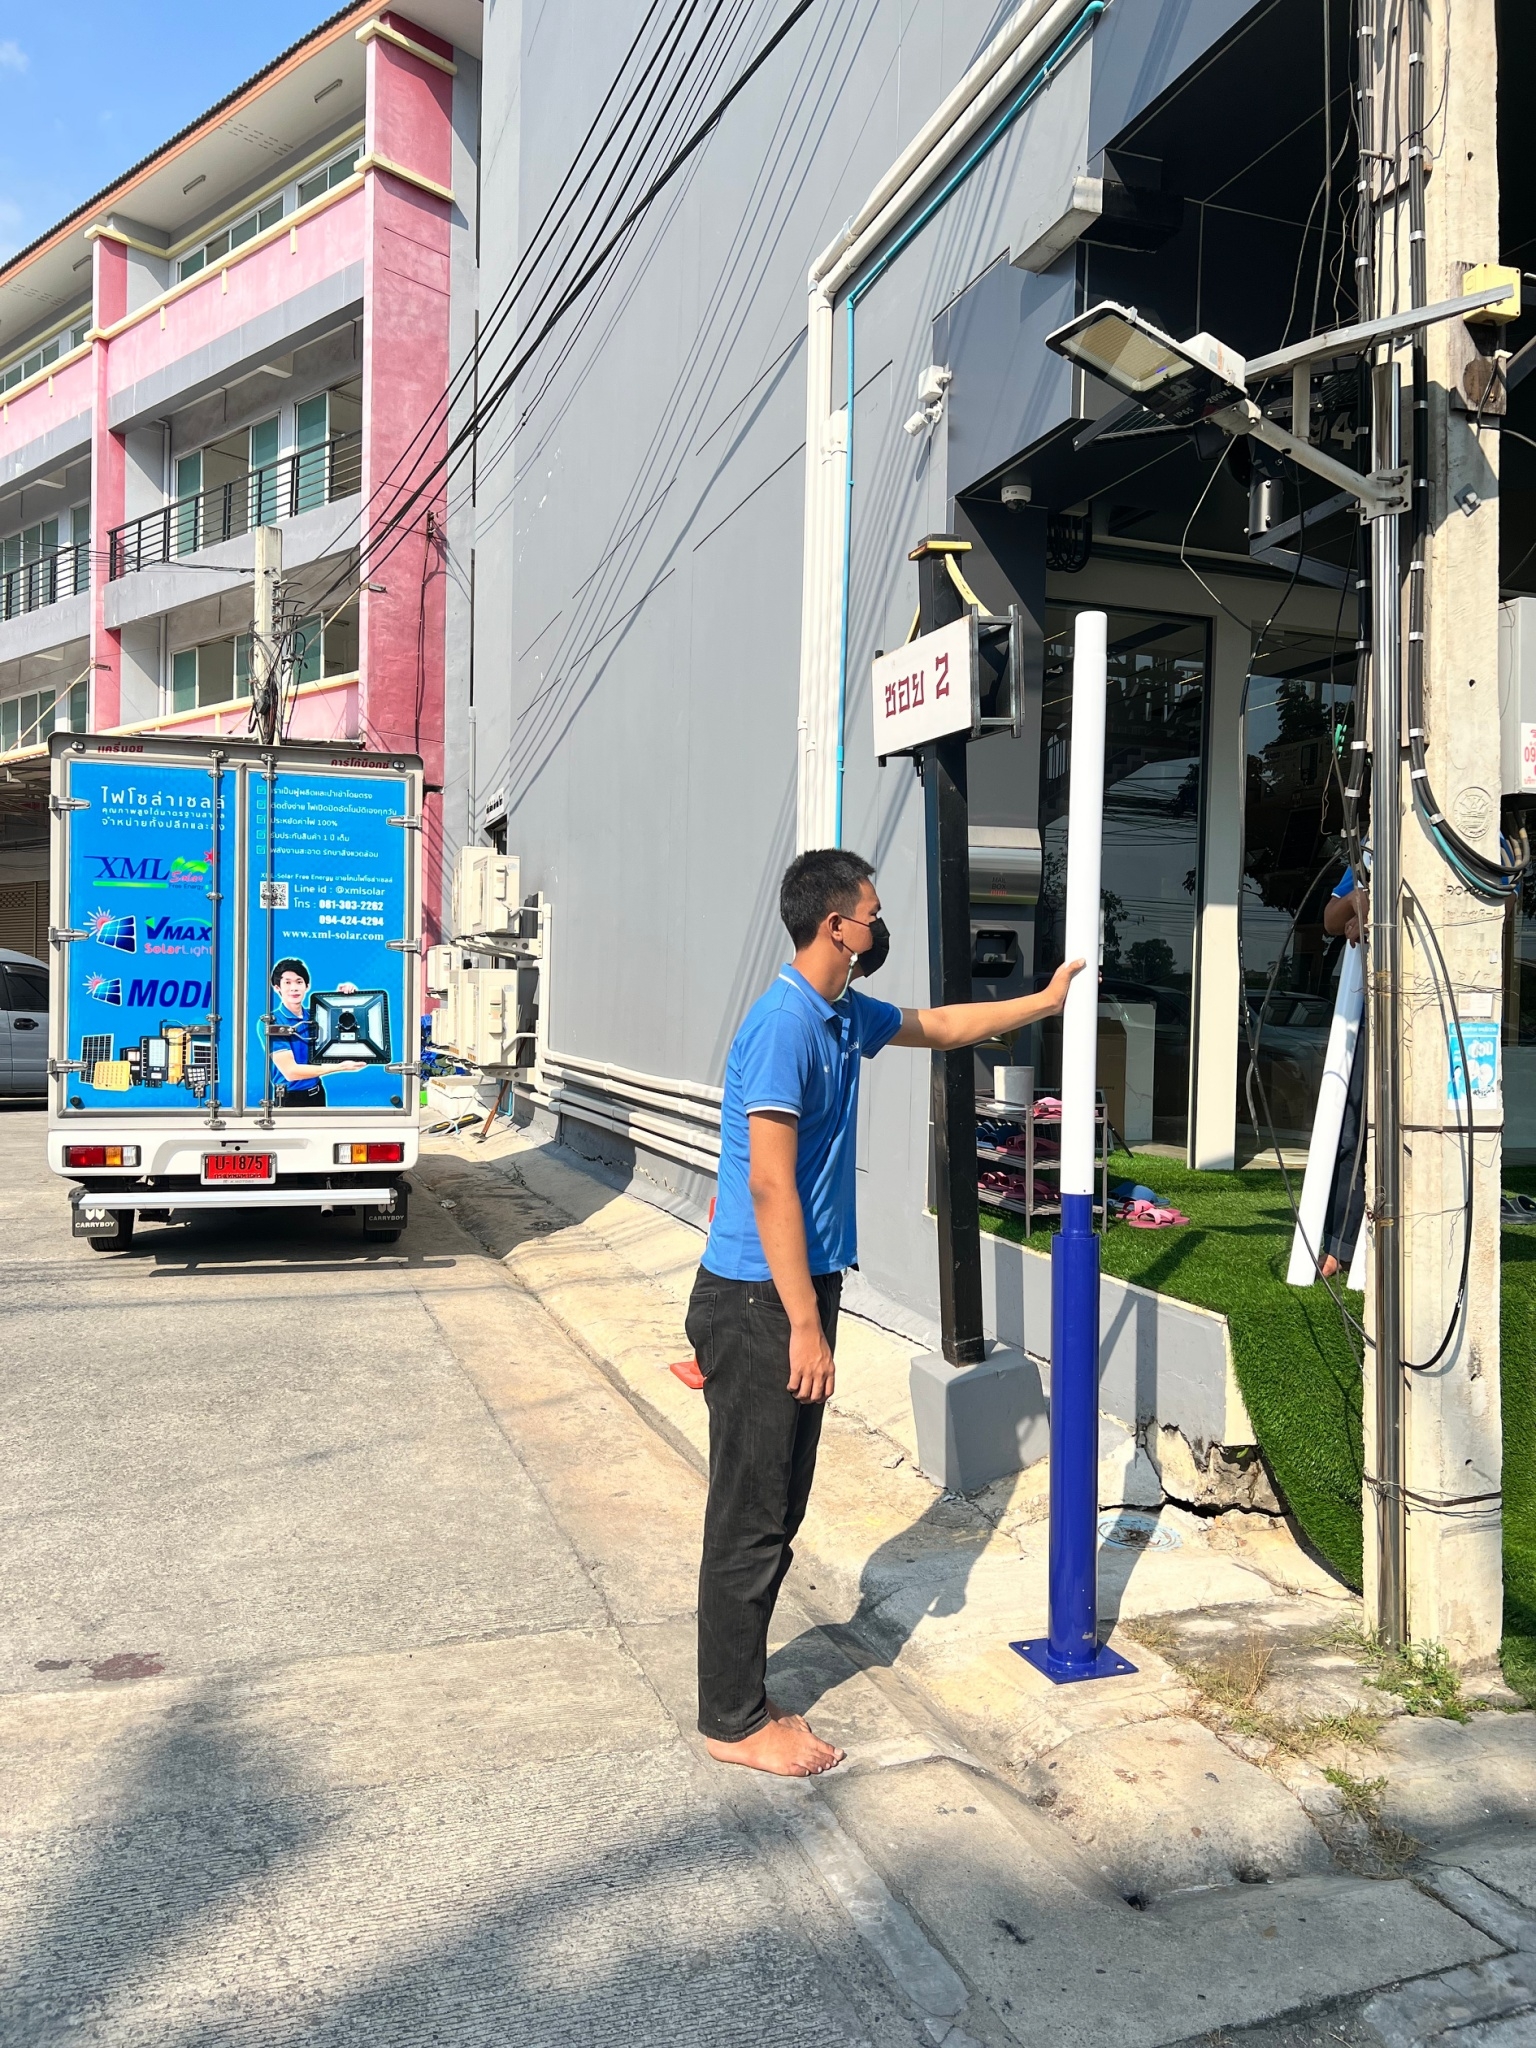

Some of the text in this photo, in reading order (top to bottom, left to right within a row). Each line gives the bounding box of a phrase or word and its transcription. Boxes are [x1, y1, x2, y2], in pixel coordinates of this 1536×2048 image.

[1206, 389, 1231, 404] 200W
[1173, 406, 1194, 418] IP65
[936, 653, 949, 699] 2
[102, 807, 225, 819] คุณภาพสูงได้มาตรฐานสาล
[102, 816, 225, 831] จำหน่ายทั้งปลีกและง
[317, 819, 338, 827] 100%
[83, 856, 170, 880] XML
[261, 872, 294, 881] XL-Solar
[294, 884, 315, 893] Line
[318, 884, 327, 893] id
[336, 885, 385, 896] @xmlsolar
[145, 916, 213, 941] VMAX
[282, 930, 384, 941] www.xml-solar.com
[127, 979, 212, 1008] MODI
